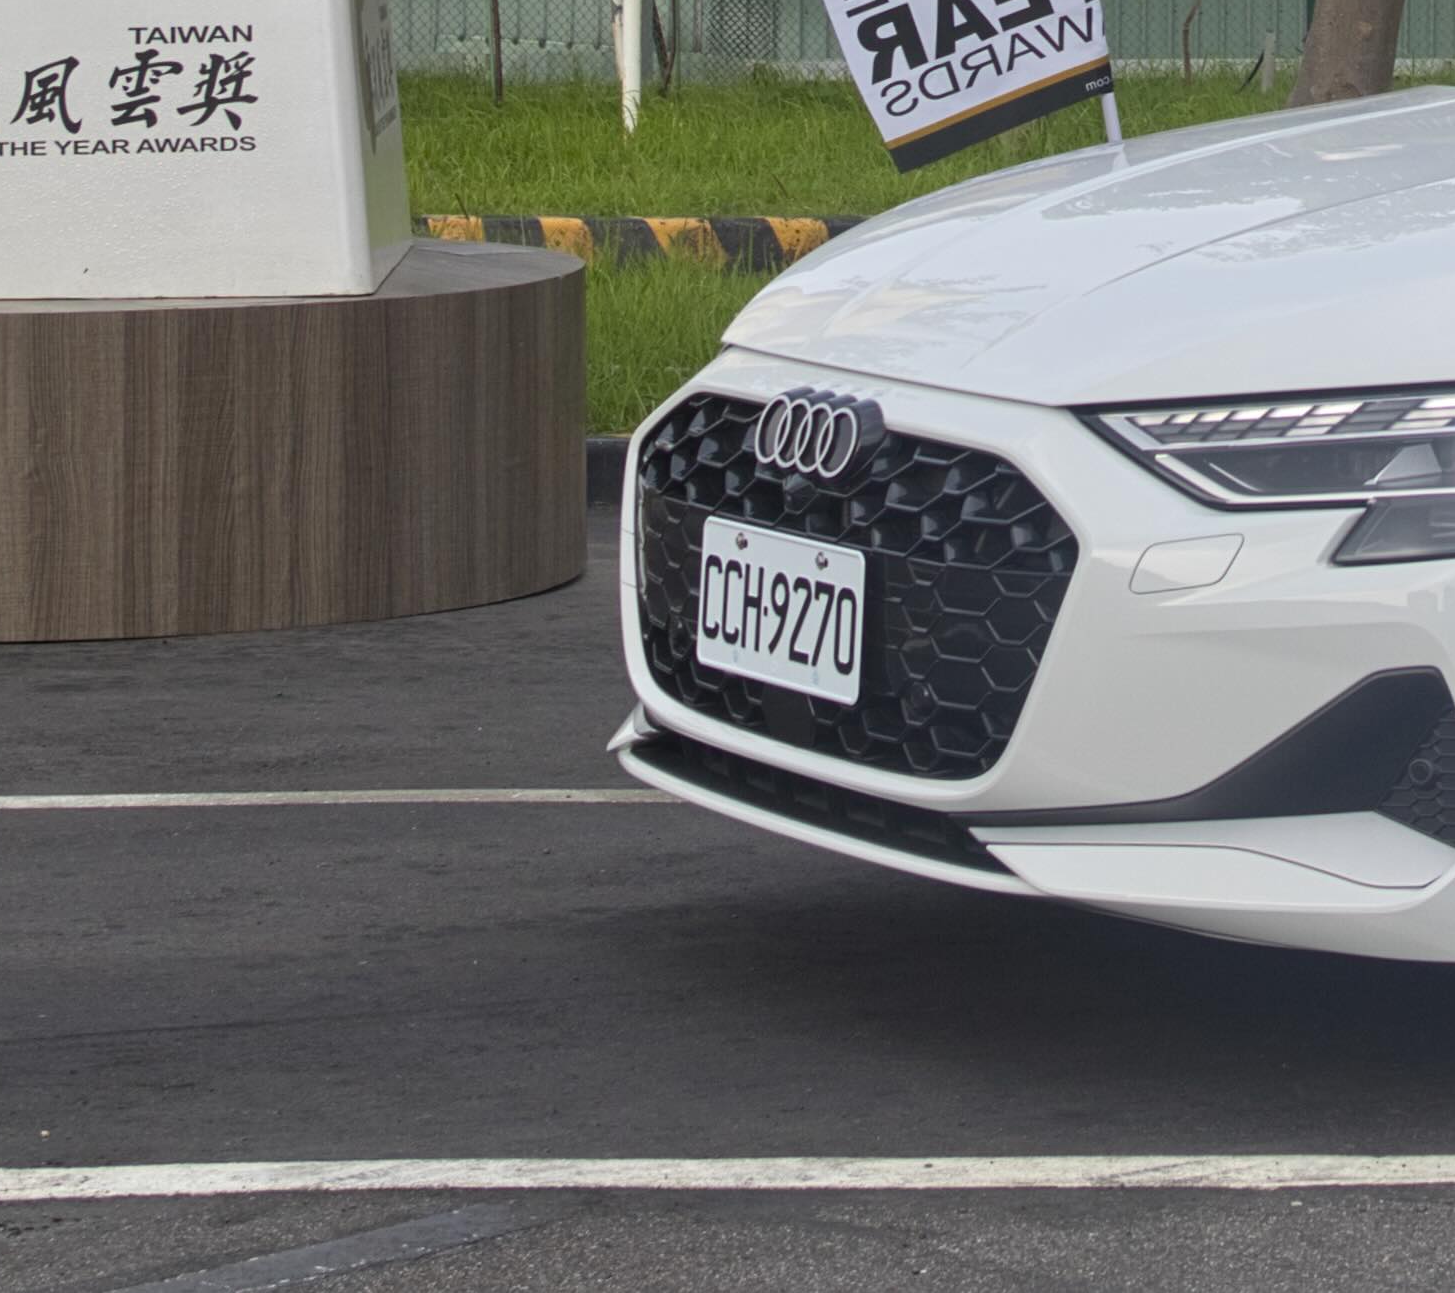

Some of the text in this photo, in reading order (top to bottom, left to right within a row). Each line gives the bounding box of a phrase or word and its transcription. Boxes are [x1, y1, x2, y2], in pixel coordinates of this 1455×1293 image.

[128, 24, 254, 45] TAIWAN
[54, 139, 130, 156] YEAR
[136, 135, 257, 154] AWARDS
